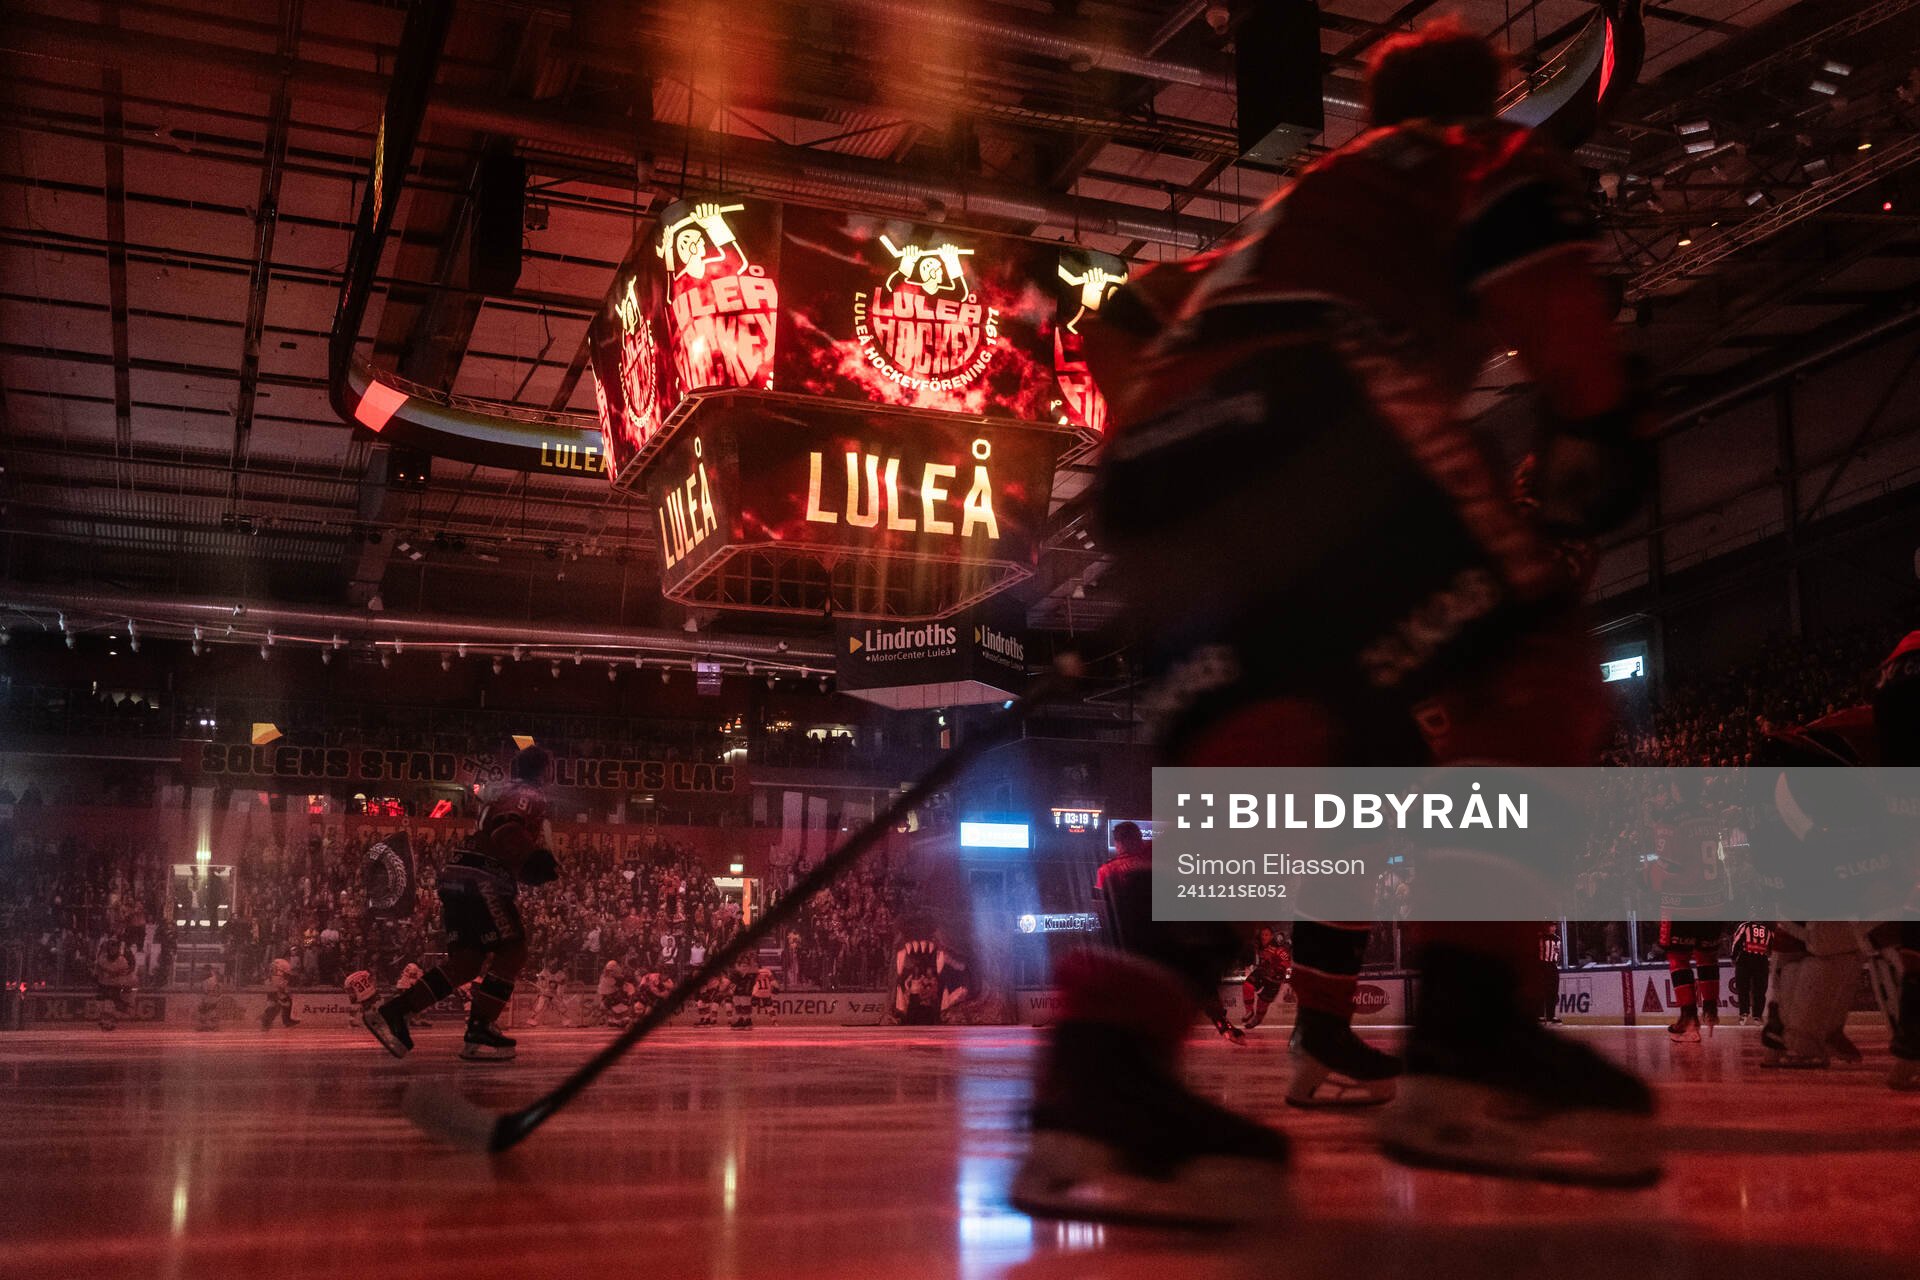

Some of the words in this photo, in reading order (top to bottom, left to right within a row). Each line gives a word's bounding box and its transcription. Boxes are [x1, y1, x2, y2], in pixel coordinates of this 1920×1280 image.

[872, 287, 982, 324] LULEÅ
[853, 291, 875, 346] LULEÅ
[864, 347, 992, 392] HOCKEYFÖRENING
[985, 307, 1000, 346] 1977
[872, 316, 980, 375] HOCKEY
[659, 436, 718, 570] LULEÅ
[806, 438, 1000, 540] LULEÅ
[865, 623, 957, 652] Lindroths
[871, 650, 925, 662] MotorCenter
[927, 647, 951, 658] Luleå
[981, 624, 1024, 662] Lindroths
[201, 744, 350, 779] SOLENS
[359, 749, 457, 782] STAD
[672, 762, 736, 793] LAG
[1065, 812, 1089, 824] 03:19
[1558, 992, 1591, 1014] MG
